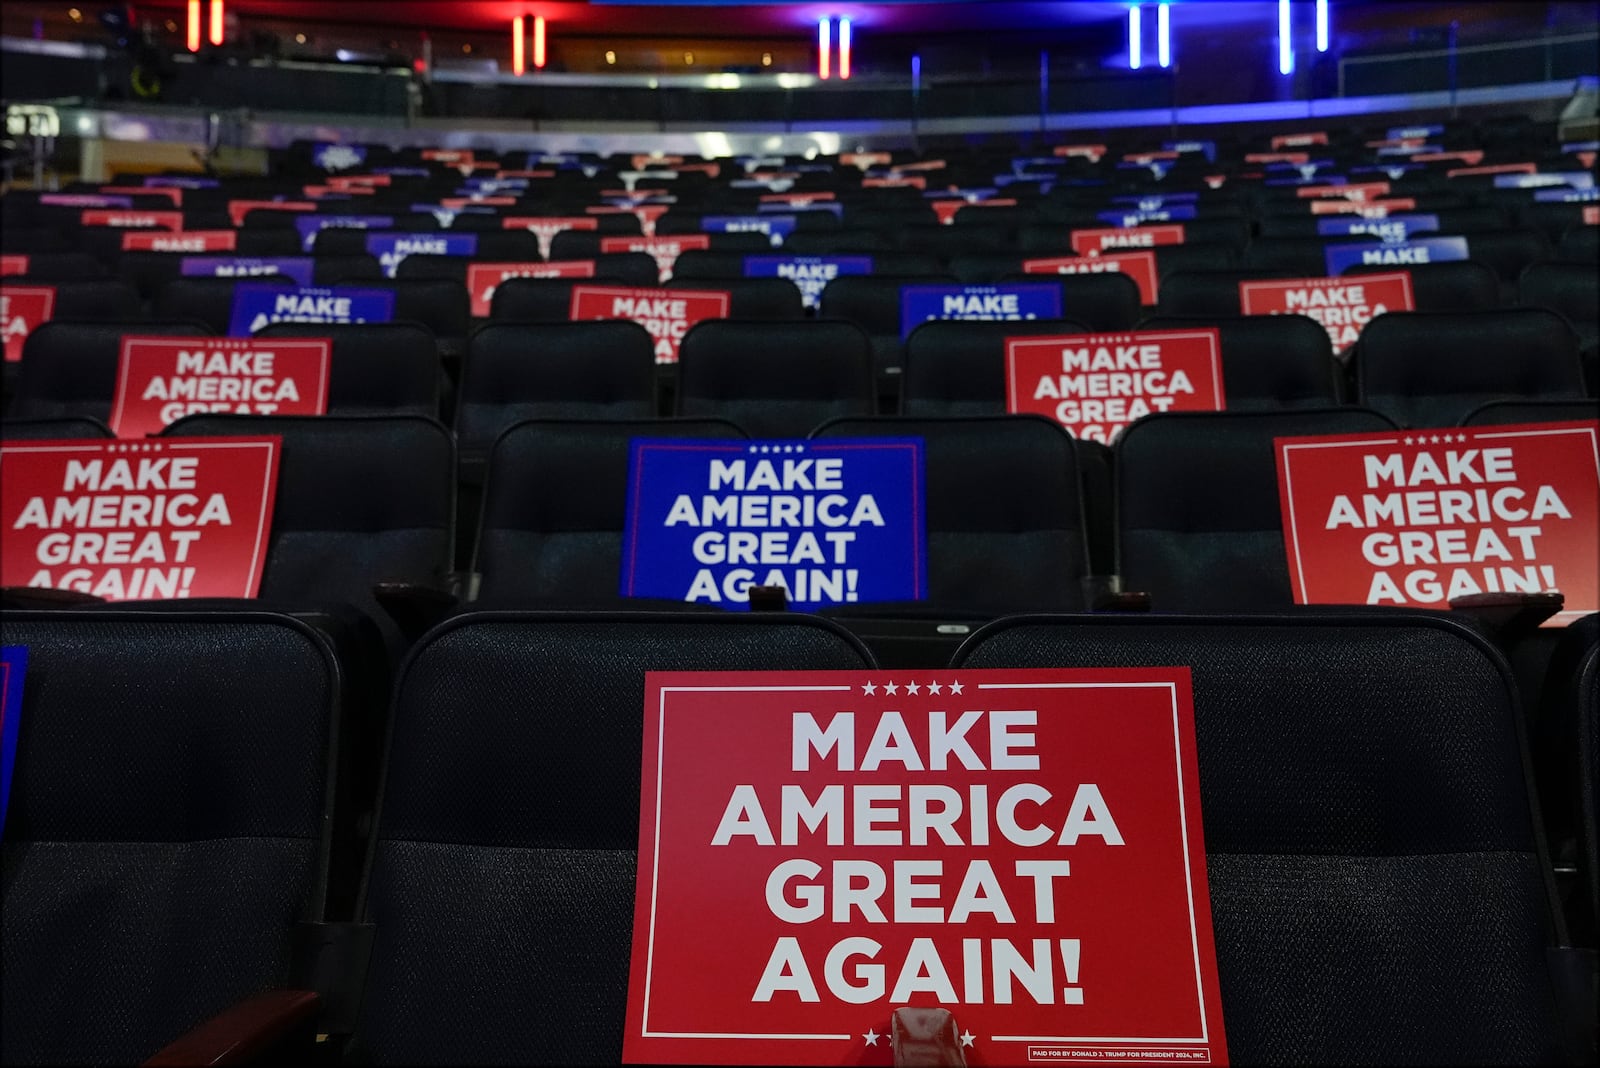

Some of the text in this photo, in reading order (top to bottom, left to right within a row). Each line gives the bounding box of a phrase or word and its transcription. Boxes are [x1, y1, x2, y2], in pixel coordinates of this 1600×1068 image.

[394, 240, 447, 253] MAKE
[1362, 247, 1430, 265] MAKE
[777, 264, 838, 280] MAKE
[275, 294, 352, 316] MAKE
[612, 297, 687, 318] MAKE
[943, 295, 1018, 314] MAKE
[1285, 285, 1365, 308] MAKE
[176, 351, 274, 375] MAKE
[1062, 345, 1162, 373] MAKE
[142, 376, 299, 401] AMERICA
[1034, 370, 1194, 400] AMERICA
[1056, 397, 1174, 424] GREAT
[63, 457, 199, 492] MAKE
[709, 458, 843, 491] MAKE
[1363, 447, 1517, 488] MAKE
[13, 493, 232, 530] AMERICA
[664, 494, 885, 527] AMERICA
[1325, 485, 1572, 530] AMERICA
[36, 530, 201, 566] GREAT
[692, 532, 856, 565] GREAT
[1362, 526, 1542, 567] GREAT
[28, 567, 196, 600] AGAIN!
[684, 568, 859, 603] AGAIN!
[1366, 565, 1559, 605] AGAIN!
[791, 710, 1041, 772] MAKE
[710, 782, 1126, 847] AMERICA
[765, 858, 1071, 924] GREAT
[751, 936, 1085, 1005] AGAIN!
